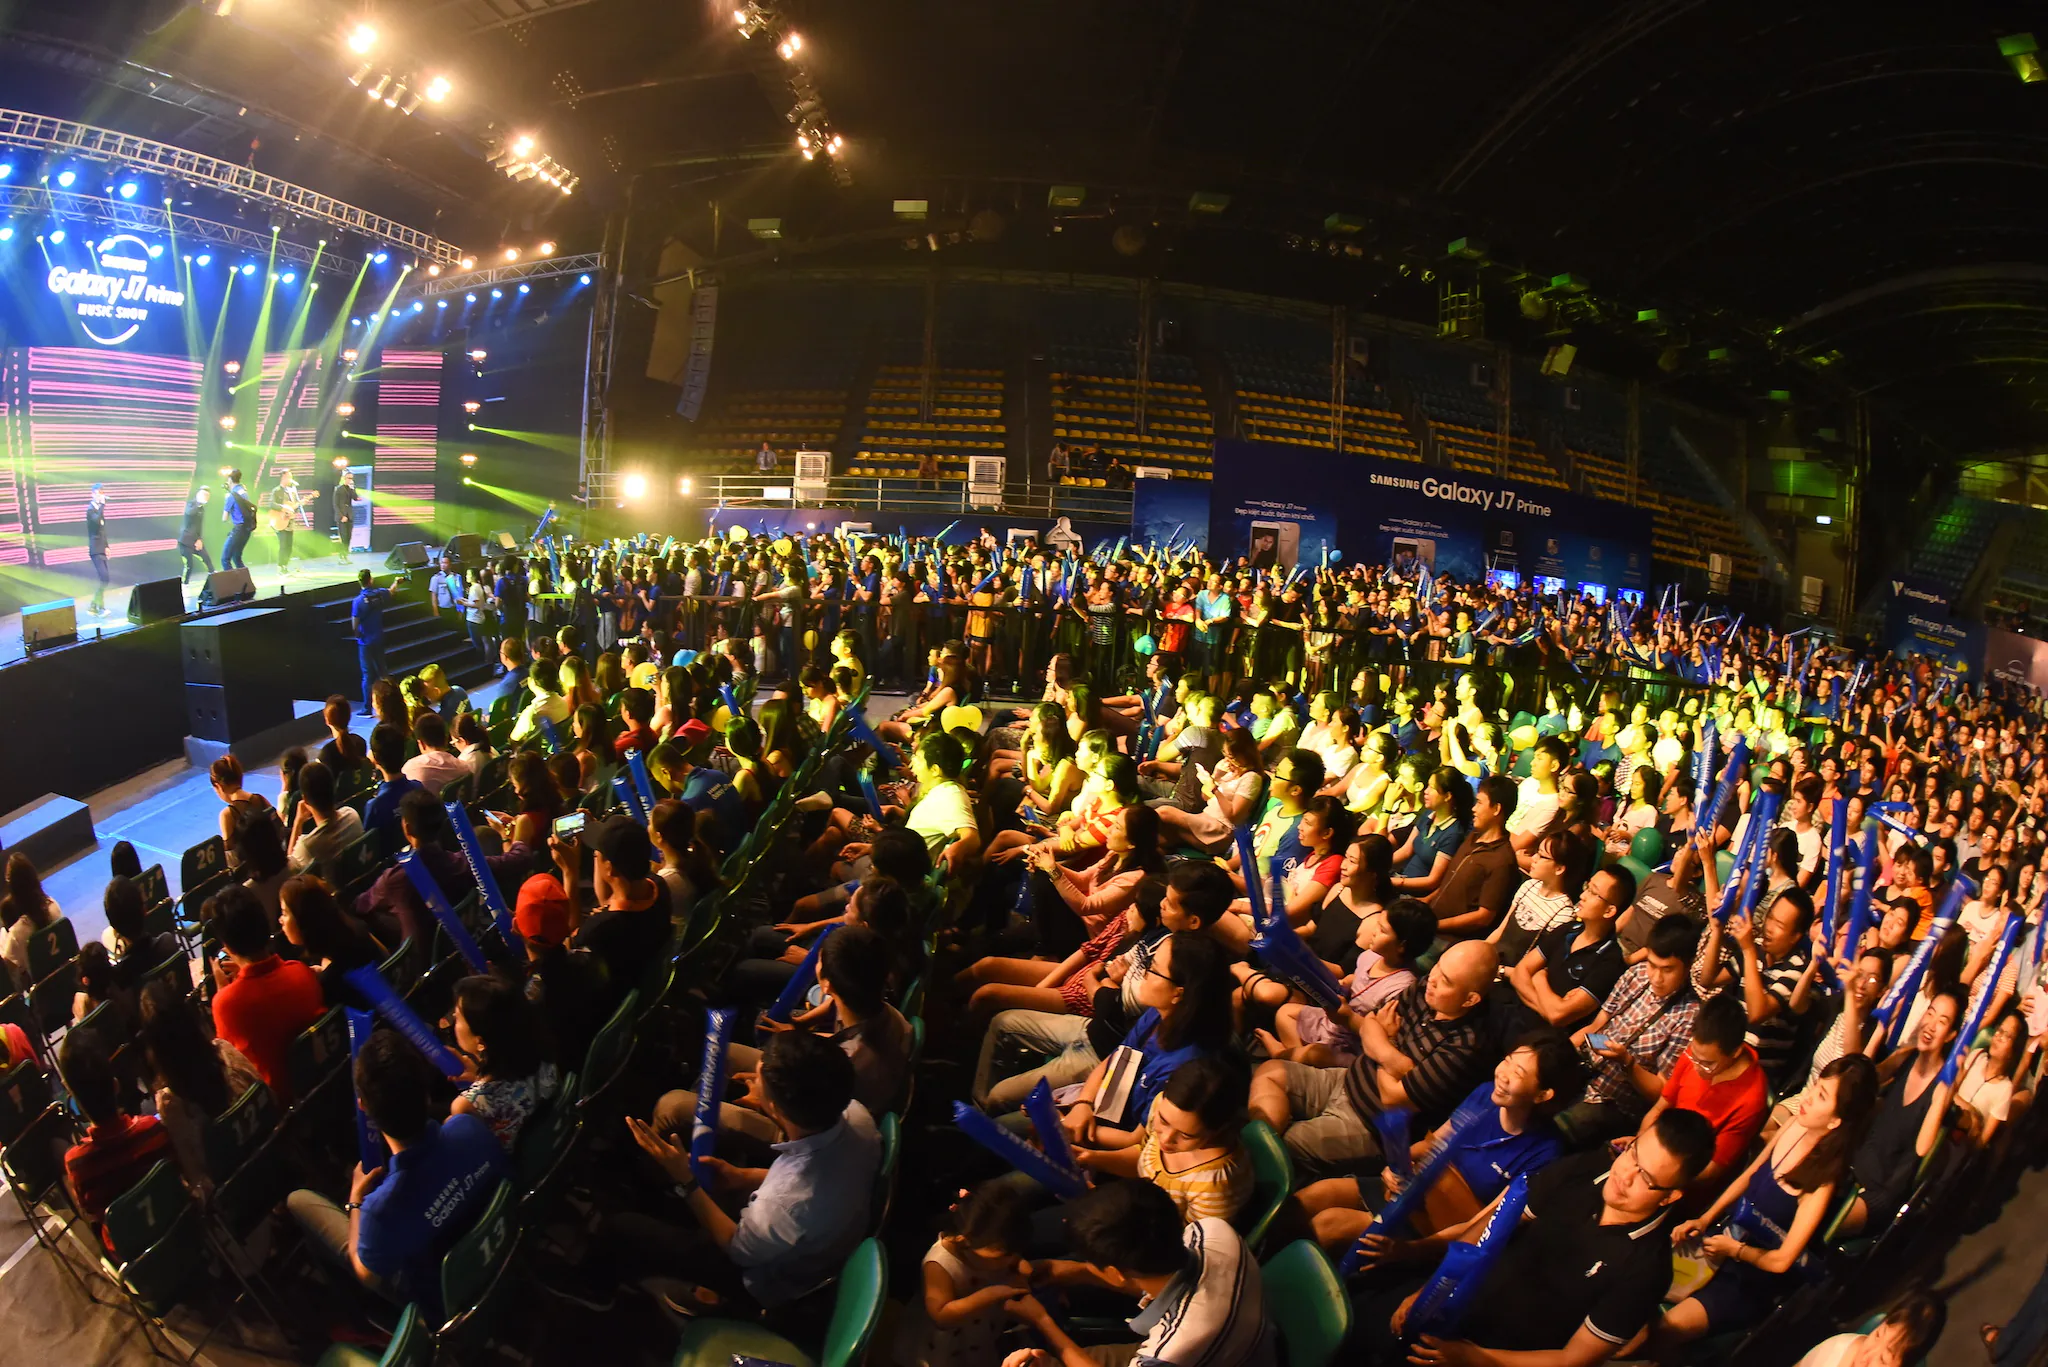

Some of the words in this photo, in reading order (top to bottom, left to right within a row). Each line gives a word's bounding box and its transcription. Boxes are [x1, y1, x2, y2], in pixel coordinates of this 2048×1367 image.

[48, 266, 125, 305] Galaxy
[121, 275, 148, 301] J7
[144, 284, 185, 306] Prime
[1370, 473, 1420, 490] SAMSUNG
[1422, 477, 1494, 511] Galaxy
[1495, 490, 1515, 510] J7
[1516, 499, 1552, 517] Prime
[196, 851, 216, 870] 26
[50, 934, 59, 956] 2
[424, 1177, 460, 1220] SAMSUNG
[432, 1187, 466, 1228] Galaxy
